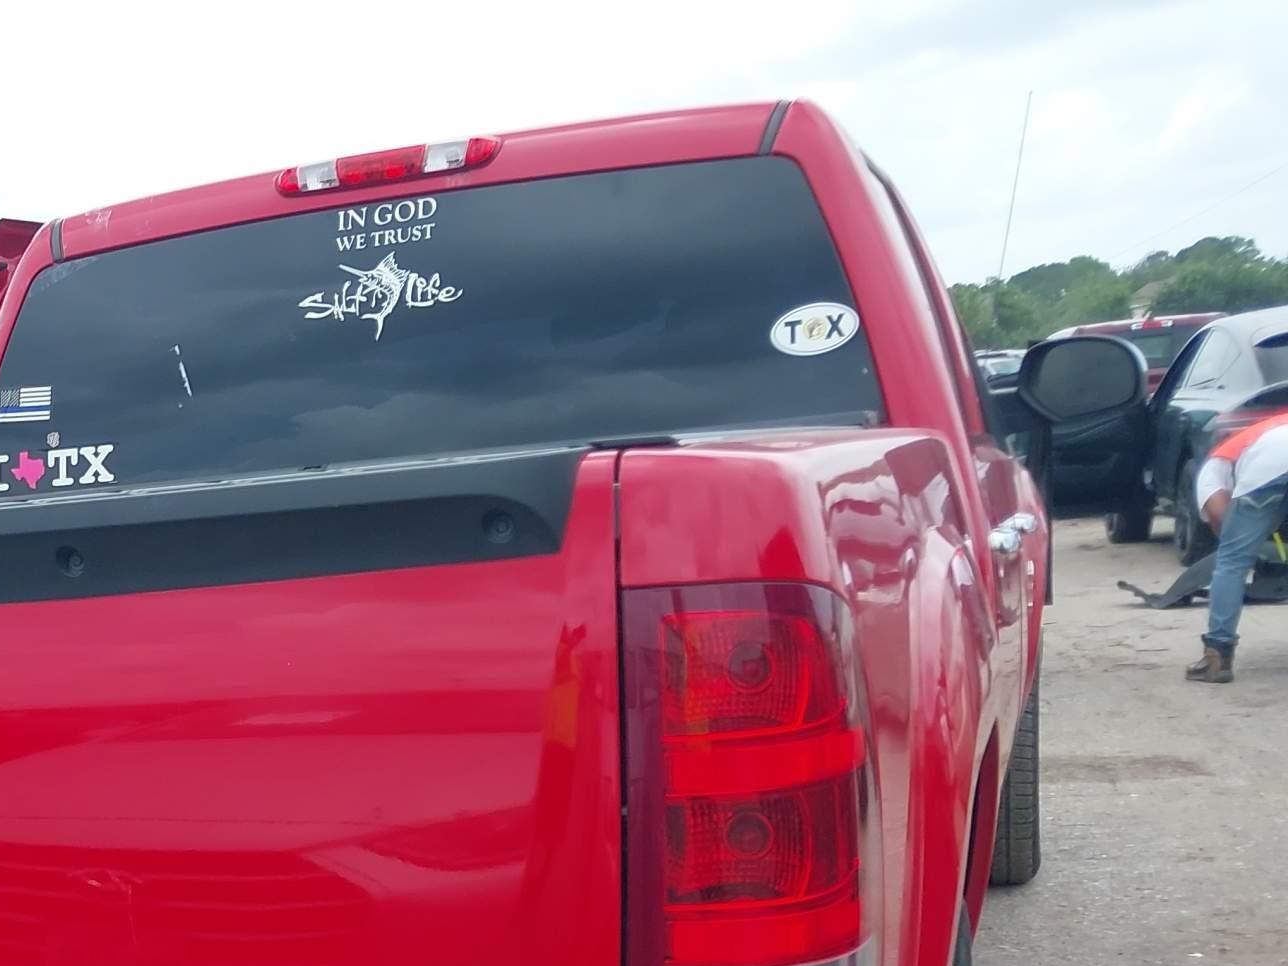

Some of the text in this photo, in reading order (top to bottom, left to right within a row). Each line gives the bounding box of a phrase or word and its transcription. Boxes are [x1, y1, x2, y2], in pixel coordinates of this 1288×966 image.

[337, 197, 438, 231] IN GOD
[336, 223, 435, 251] WE TRUST
[47, 444, 115, 487] TX
